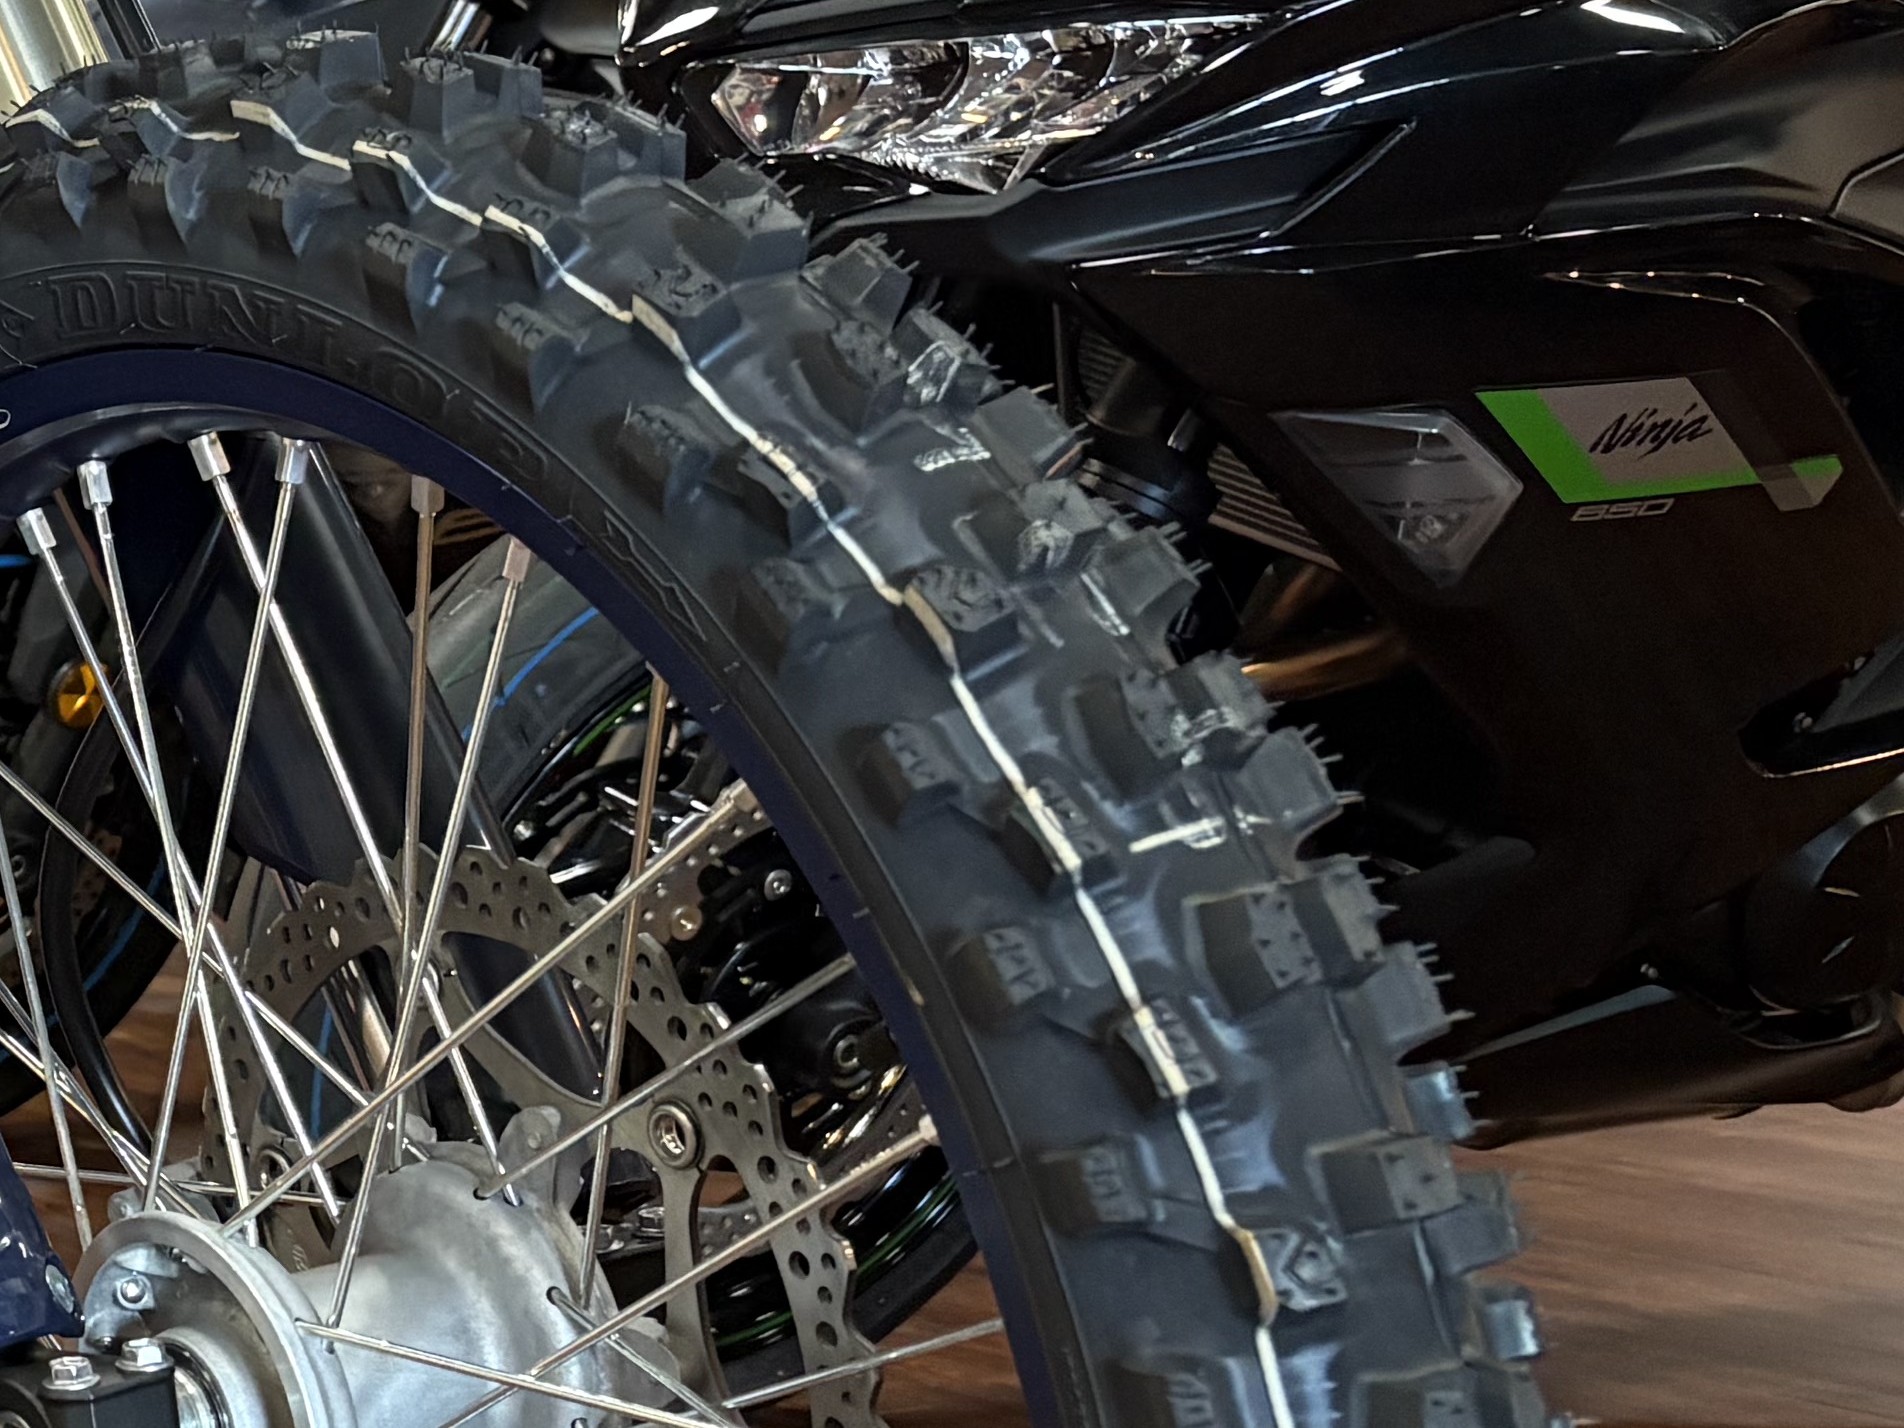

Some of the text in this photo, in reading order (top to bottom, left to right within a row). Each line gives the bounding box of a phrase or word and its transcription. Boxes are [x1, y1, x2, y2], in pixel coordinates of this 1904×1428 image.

[42, 266, 554, 484] DUNLOP
[1591, 403, 1714, 459] Ninja
[1570, 498, 1675, 522] 650
